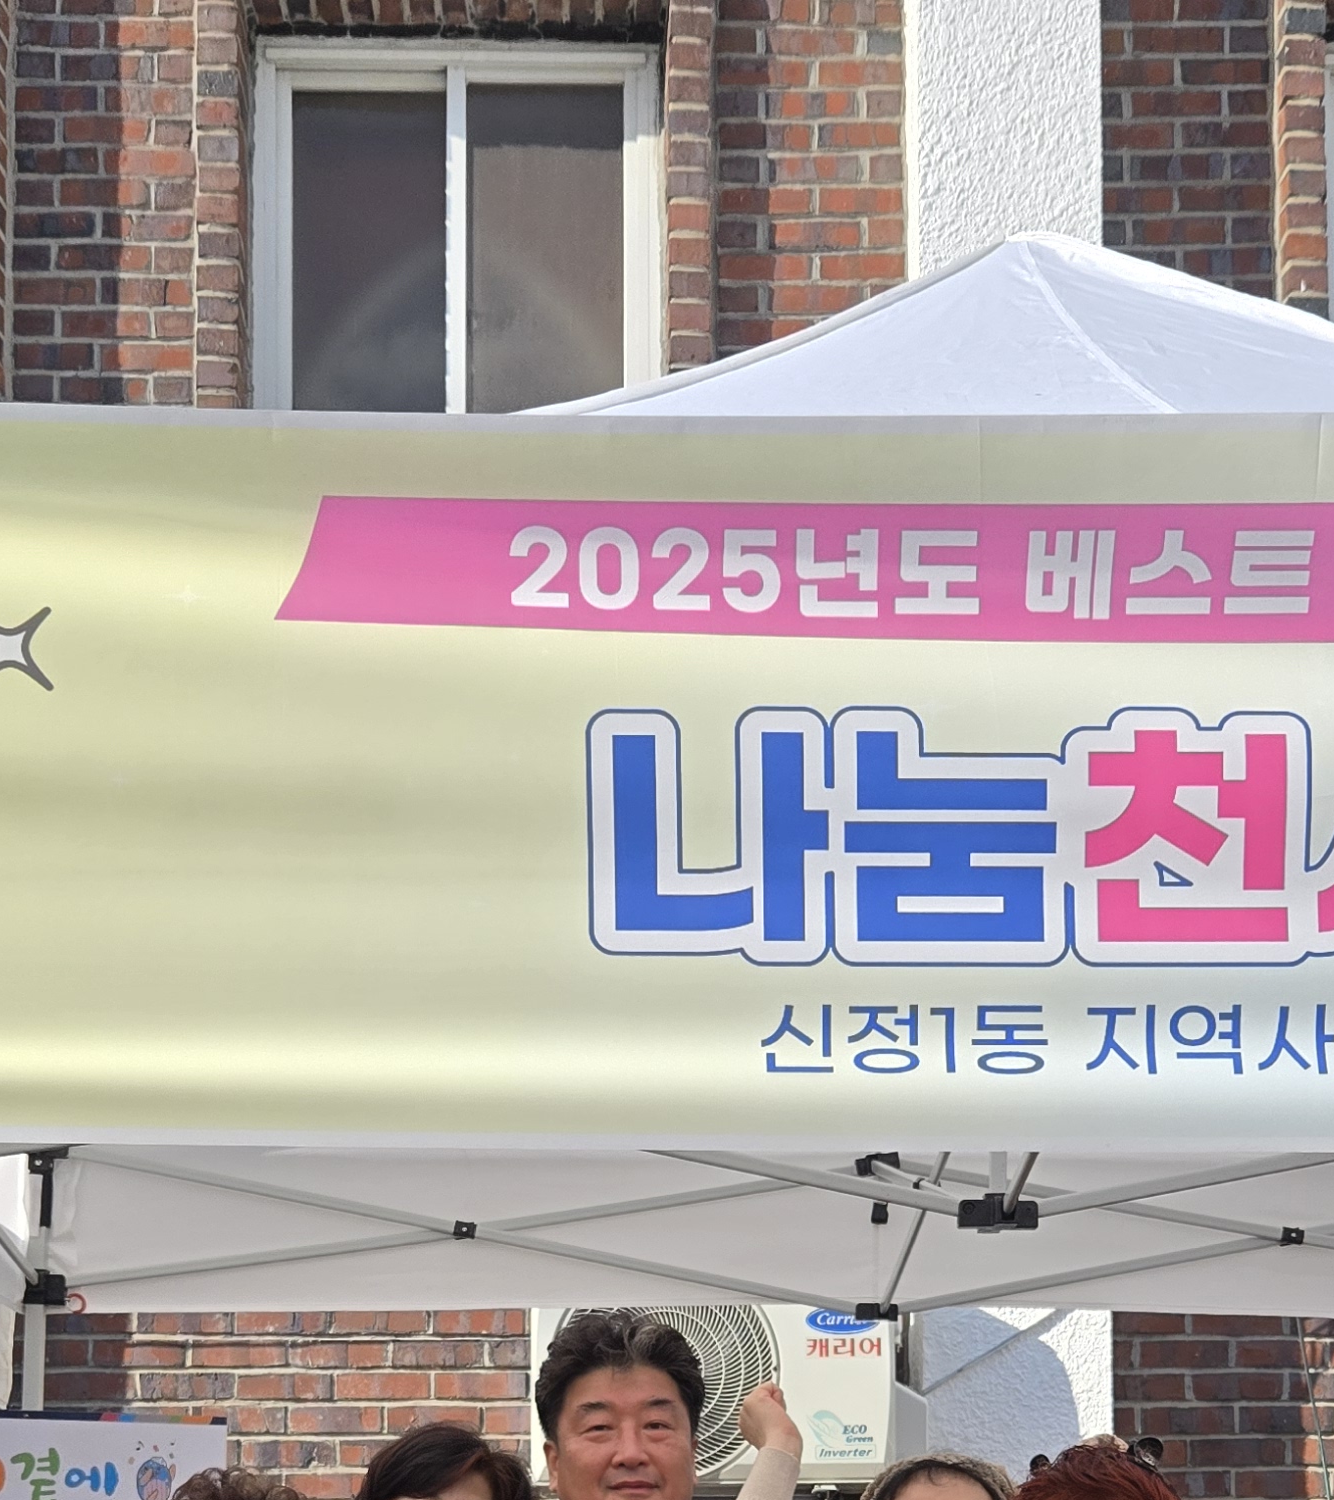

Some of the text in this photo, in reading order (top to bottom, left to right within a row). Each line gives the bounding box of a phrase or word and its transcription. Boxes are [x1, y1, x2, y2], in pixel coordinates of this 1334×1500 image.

[509, 526, 980, 617] 2025년도
[1025, 528, 1315, 619] 베스트
[759, 1002, 1050, 1076] 신정1동
[816, 1312, 868, 1326] Carri
[806, 1337, 881, 1358] 캐리어
[842, 1424, 868, 1435] ECO
[845, 1434, 874, 1444] Green
[819, 1448, 873, 1458] Inverter
